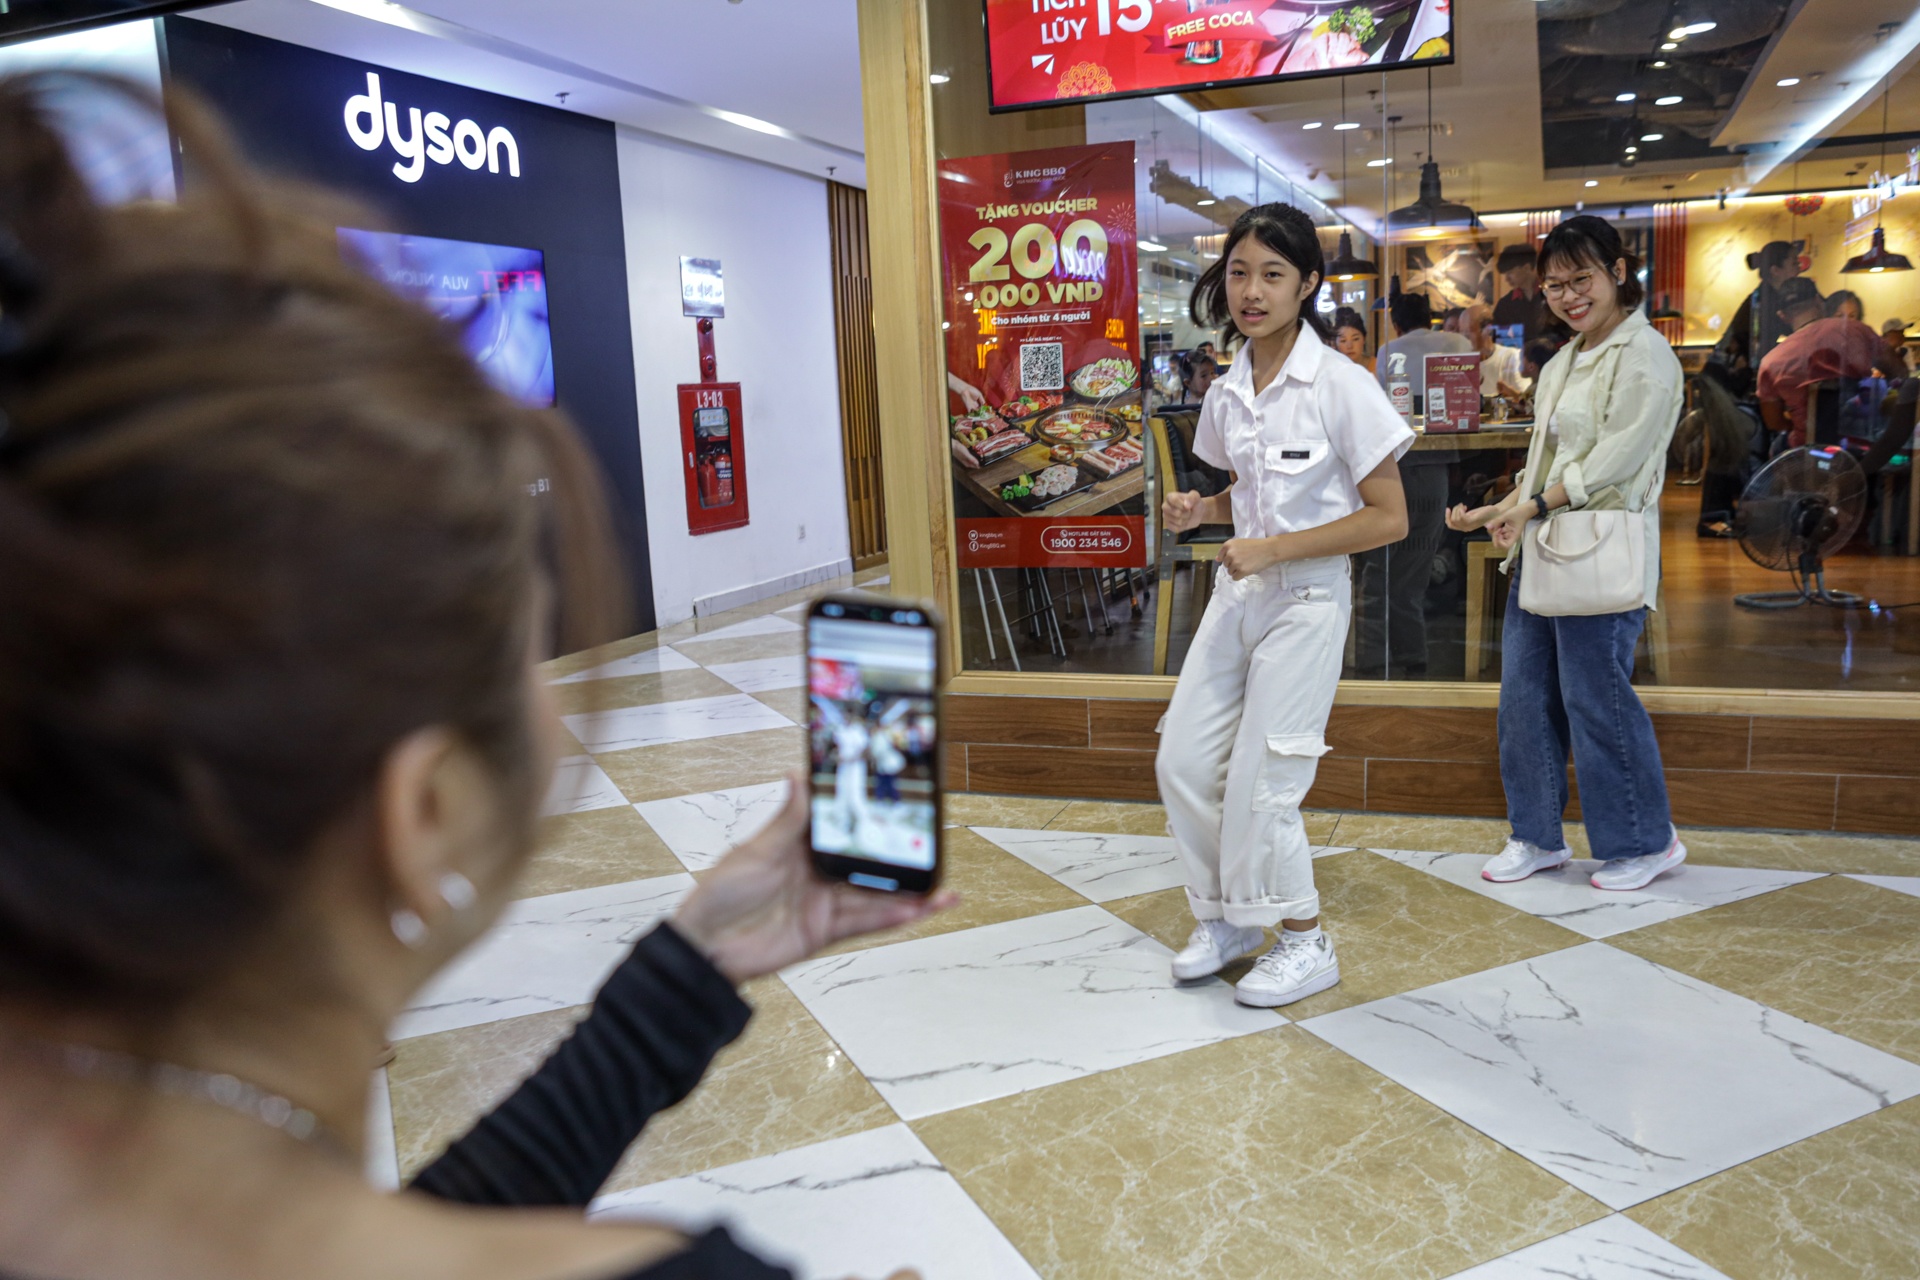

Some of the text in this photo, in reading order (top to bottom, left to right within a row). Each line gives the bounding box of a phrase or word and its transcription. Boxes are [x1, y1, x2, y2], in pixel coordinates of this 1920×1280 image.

[1041, 16, 1088, 45] LŨY
[1167, 10, 1254, 40] FREE COCA
[344, 72, 521, 183] dyson
[1015, 169, 1041, 179] KING
[976, 197, 1098, 223] TẶNG VOUCHER
[967, 219, 1108, 283] 200
[1046, 281, 1103, 304] VND
[990, 311, 1091, 326] Cho nhóm từ 4 người
[1050, 537, 1122, 548] 1900 234 546
